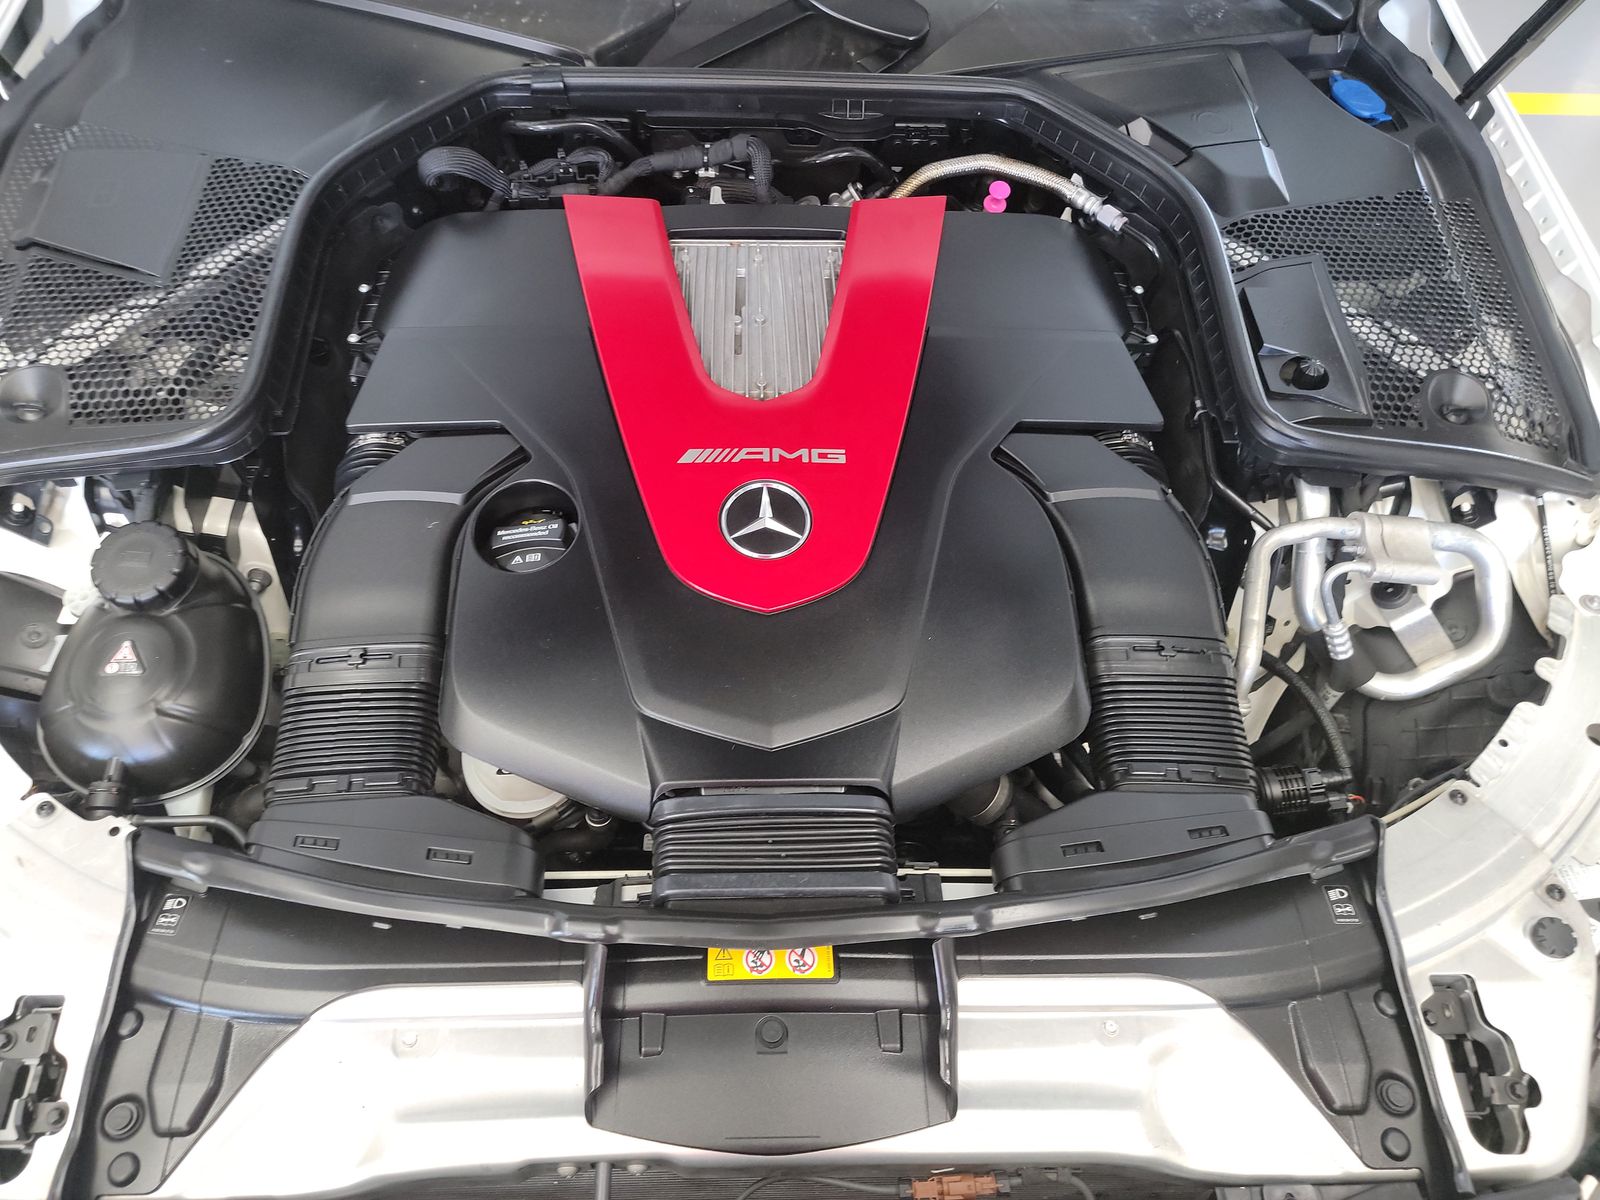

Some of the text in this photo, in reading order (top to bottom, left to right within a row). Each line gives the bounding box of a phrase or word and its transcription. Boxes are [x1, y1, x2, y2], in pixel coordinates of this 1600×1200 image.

[731, 447, 847, 464] AMG
[497, 525, 548, 535] Mercedes-Benz
[502, 530, 549, 540] recommended
